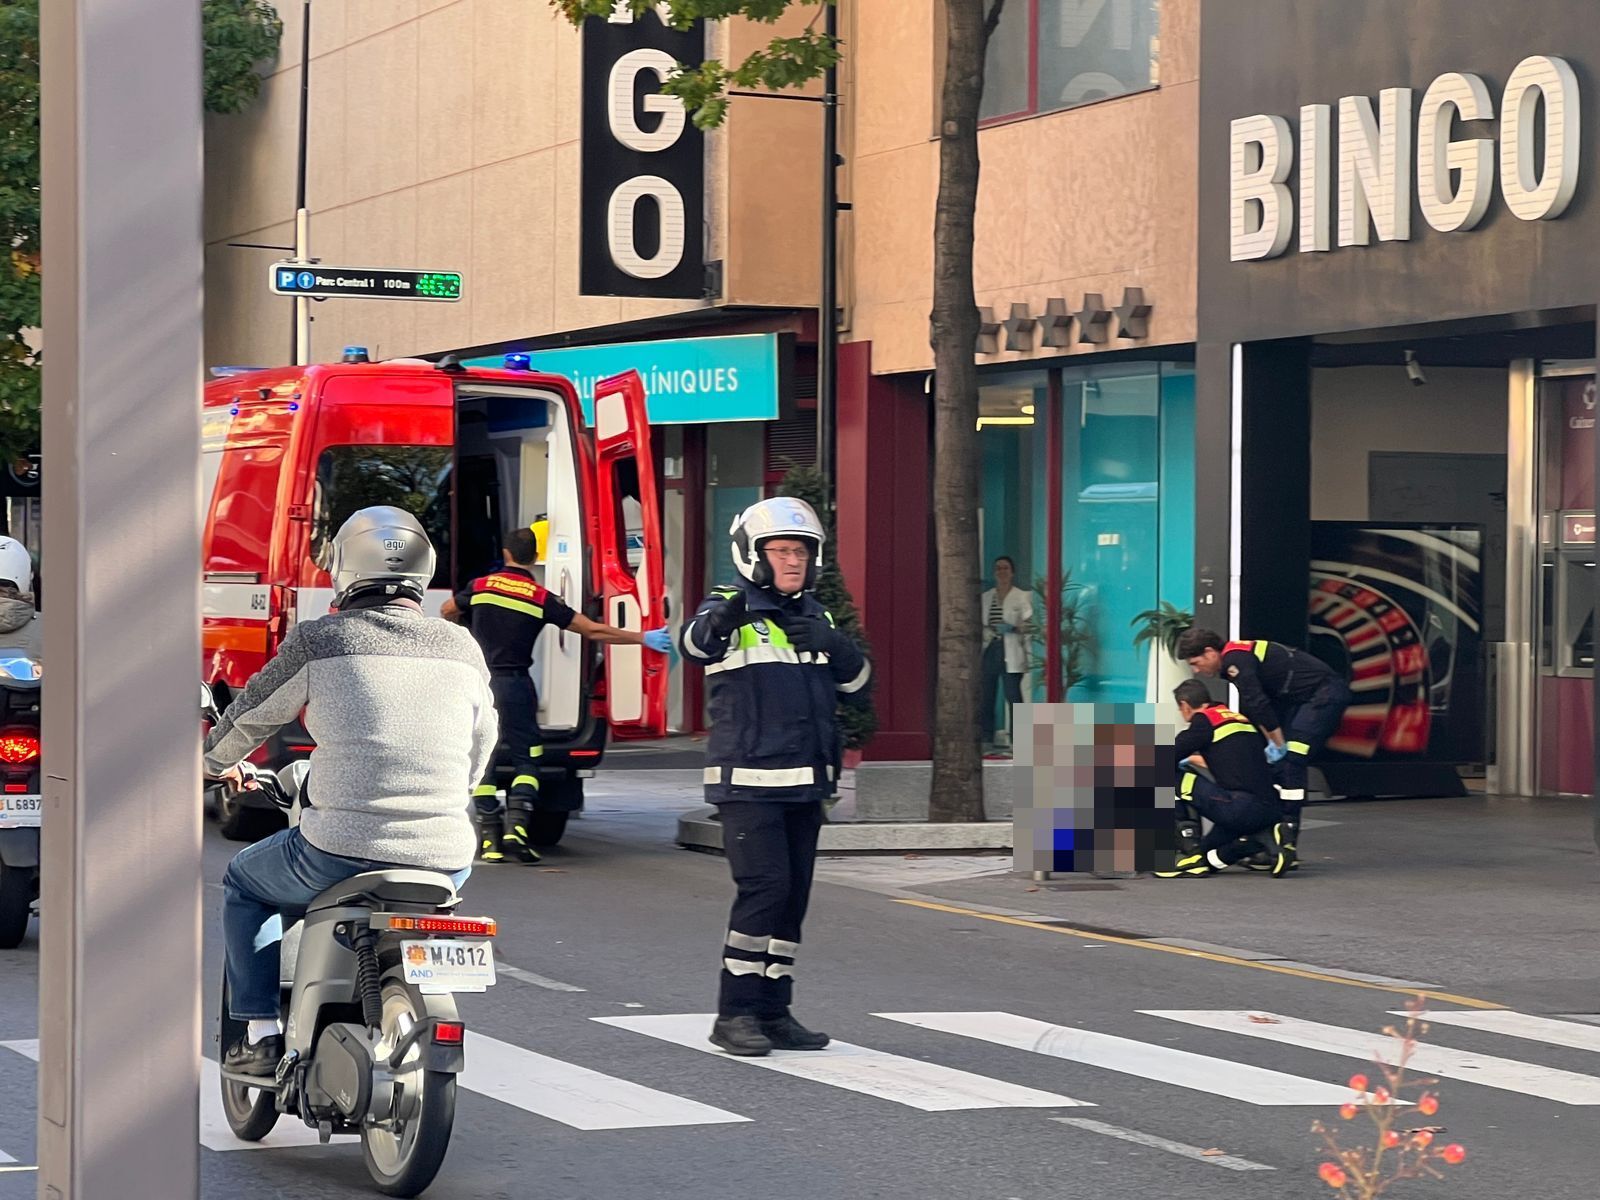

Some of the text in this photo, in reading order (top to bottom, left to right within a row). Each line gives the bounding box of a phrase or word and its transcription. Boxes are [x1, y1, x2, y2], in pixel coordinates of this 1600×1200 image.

[1230, 55, 1580, 262] BINGO
[281, 272, 294, 287] P
[315, 276, 335, 286] Parc
[336, 277, 368, 288] Central
[369, 279, 375, 288] 1
[383, 279, 411, 289] 100m
[431, 947, 487, 966] M4812
[410, 969, 433, 978] AND
